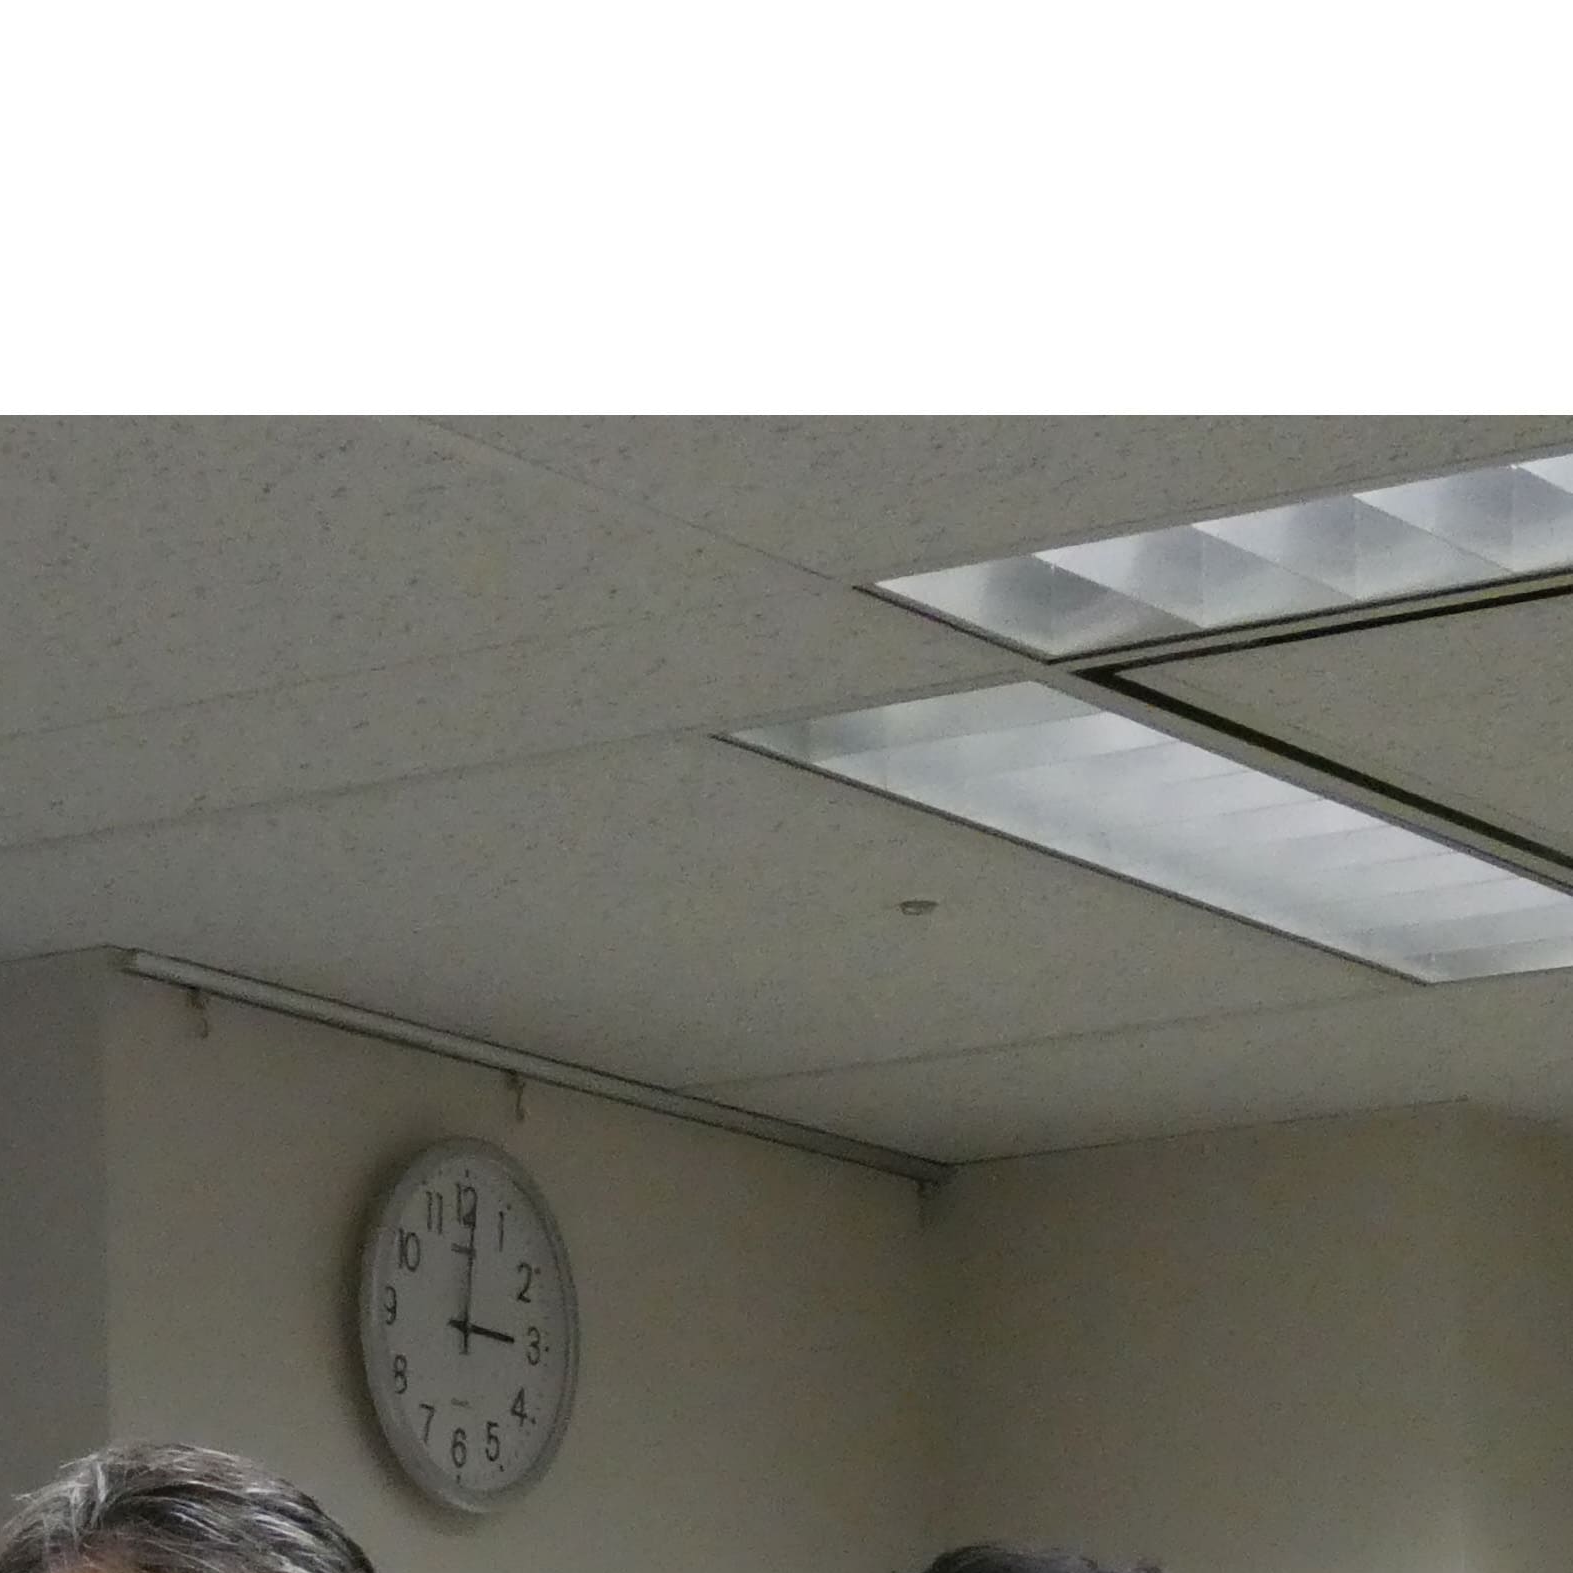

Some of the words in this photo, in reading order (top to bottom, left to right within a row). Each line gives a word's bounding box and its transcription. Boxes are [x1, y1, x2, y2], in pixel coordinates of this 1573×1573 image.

[426, 1191, 444, 1235] 11
[456, 1182, 477, 1228] 12
[398, 1228, 421, 1272] 10
[517, 1263, 533, 1304] 2
[384, 1287, 398, 1326] 9
[527, 1326, 542, 1366] 3
[392, 1355, 408, 1395] 8
[420, 1404, 435, 1443] 7
[511, 1387, 528, 1427] 4
[451, 1428, 467, 1468] 6
[485, 1421, 500, 1462] 5
